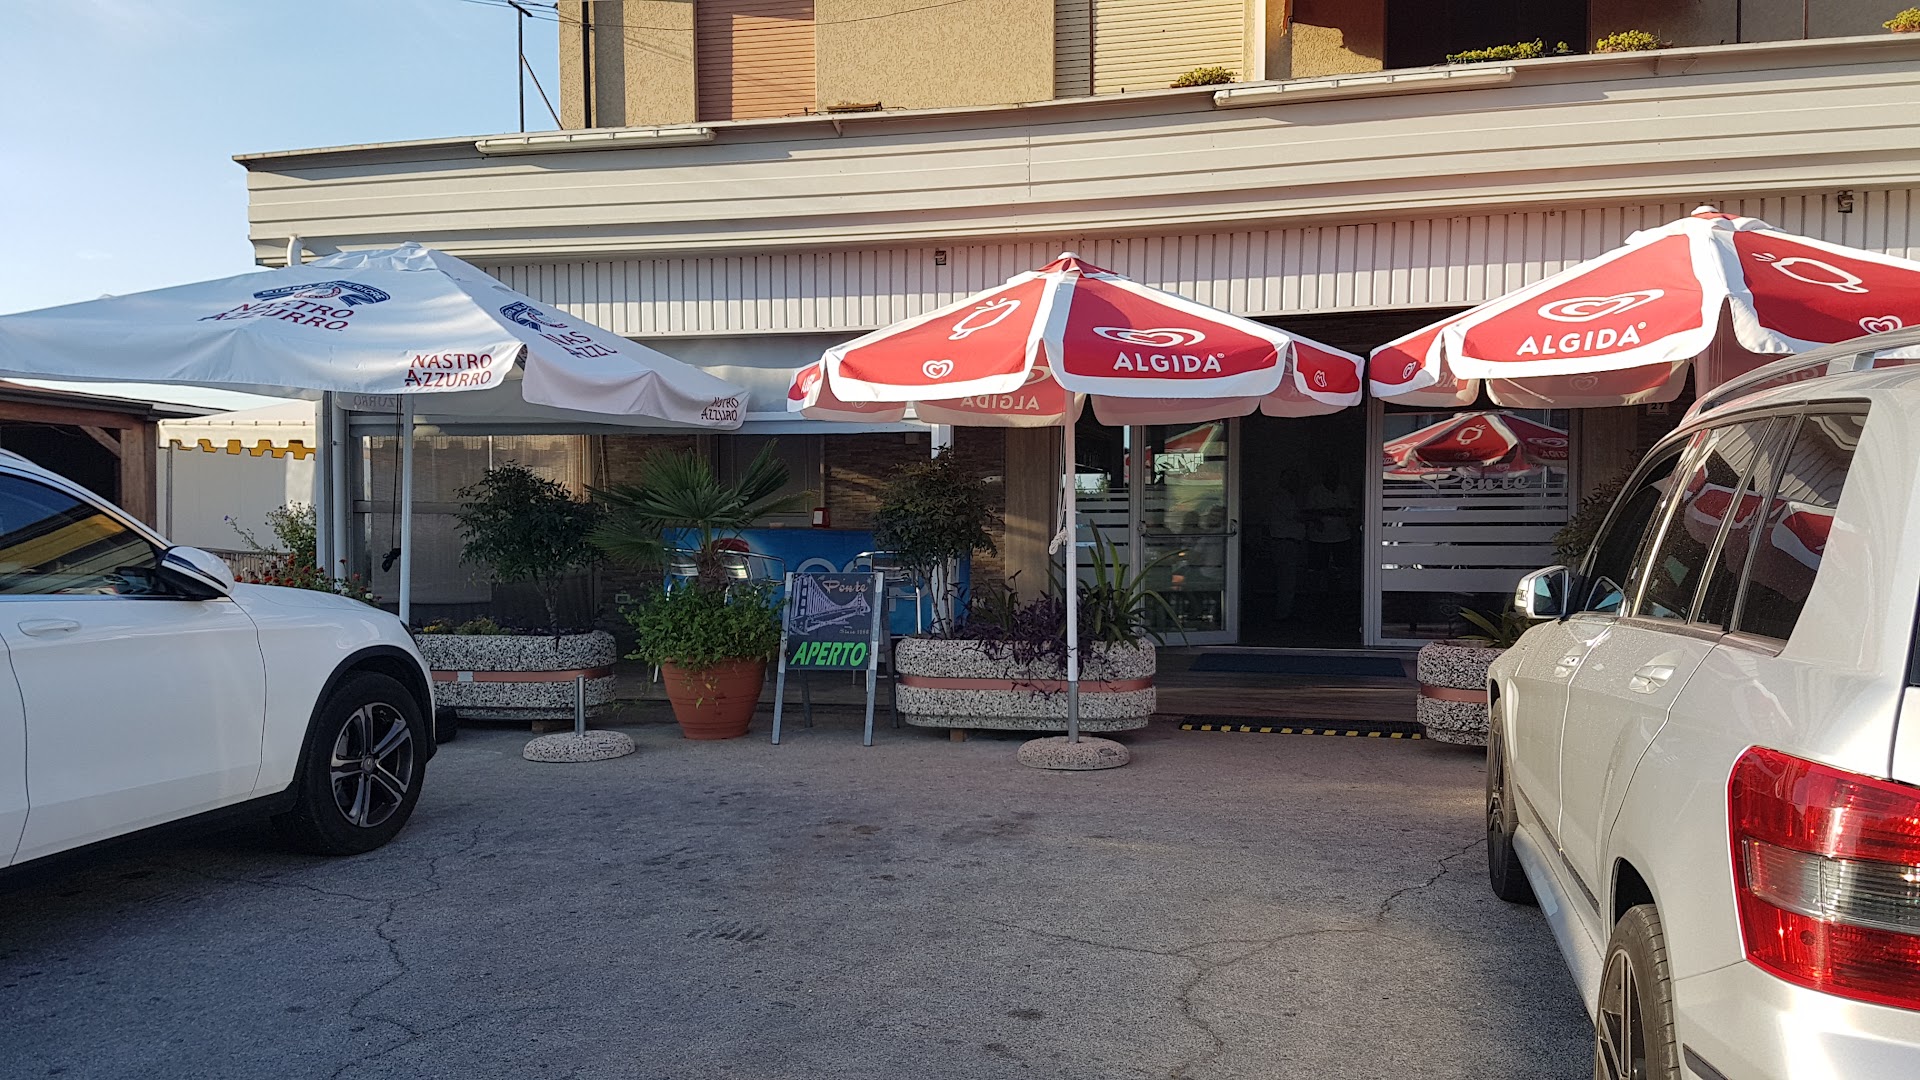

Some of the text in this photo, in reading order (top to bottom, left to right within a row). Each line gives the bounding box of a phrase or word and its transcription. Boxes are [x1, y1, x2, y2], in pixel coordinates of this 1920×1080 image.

[227, 300, 355, 319] NASTRO
[197, 308, 349, 331] AZZURRO
[411, 353, 492, 369] NASTRO
[405, 369, 492, 387] AZZURRO
[1420, 467, 1531, 495] Ponte
[822, 580, 869, 594] Ponte
[790, 641, 868, 667] APERTO
